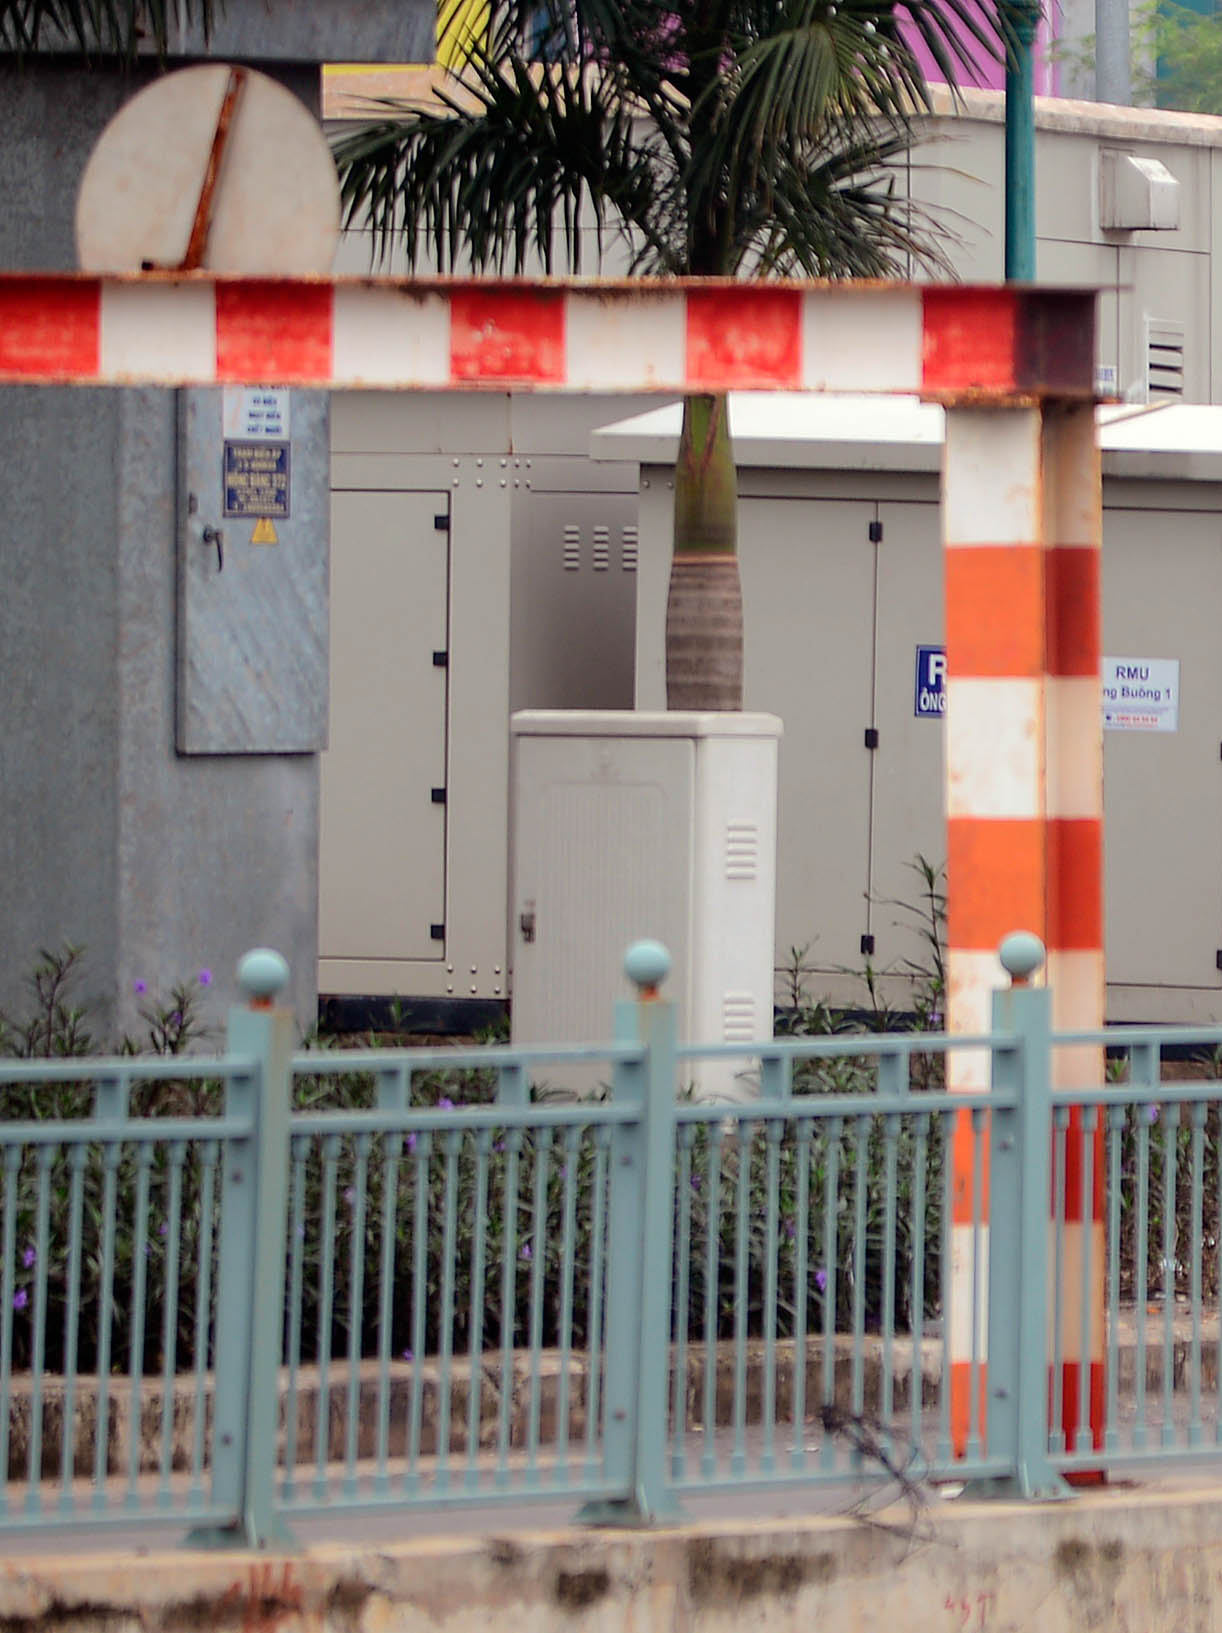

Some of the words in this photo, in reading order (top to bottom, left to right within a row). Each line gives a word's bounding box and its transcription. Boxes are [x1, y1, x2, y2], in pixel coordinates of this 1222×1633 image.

[1116, 665, 1149, 681] RMU
[1103, 687, 1117, 700] ng
[1122, 685, 1161, 702] Buông
[1165, 687, 1171, 700] 1
